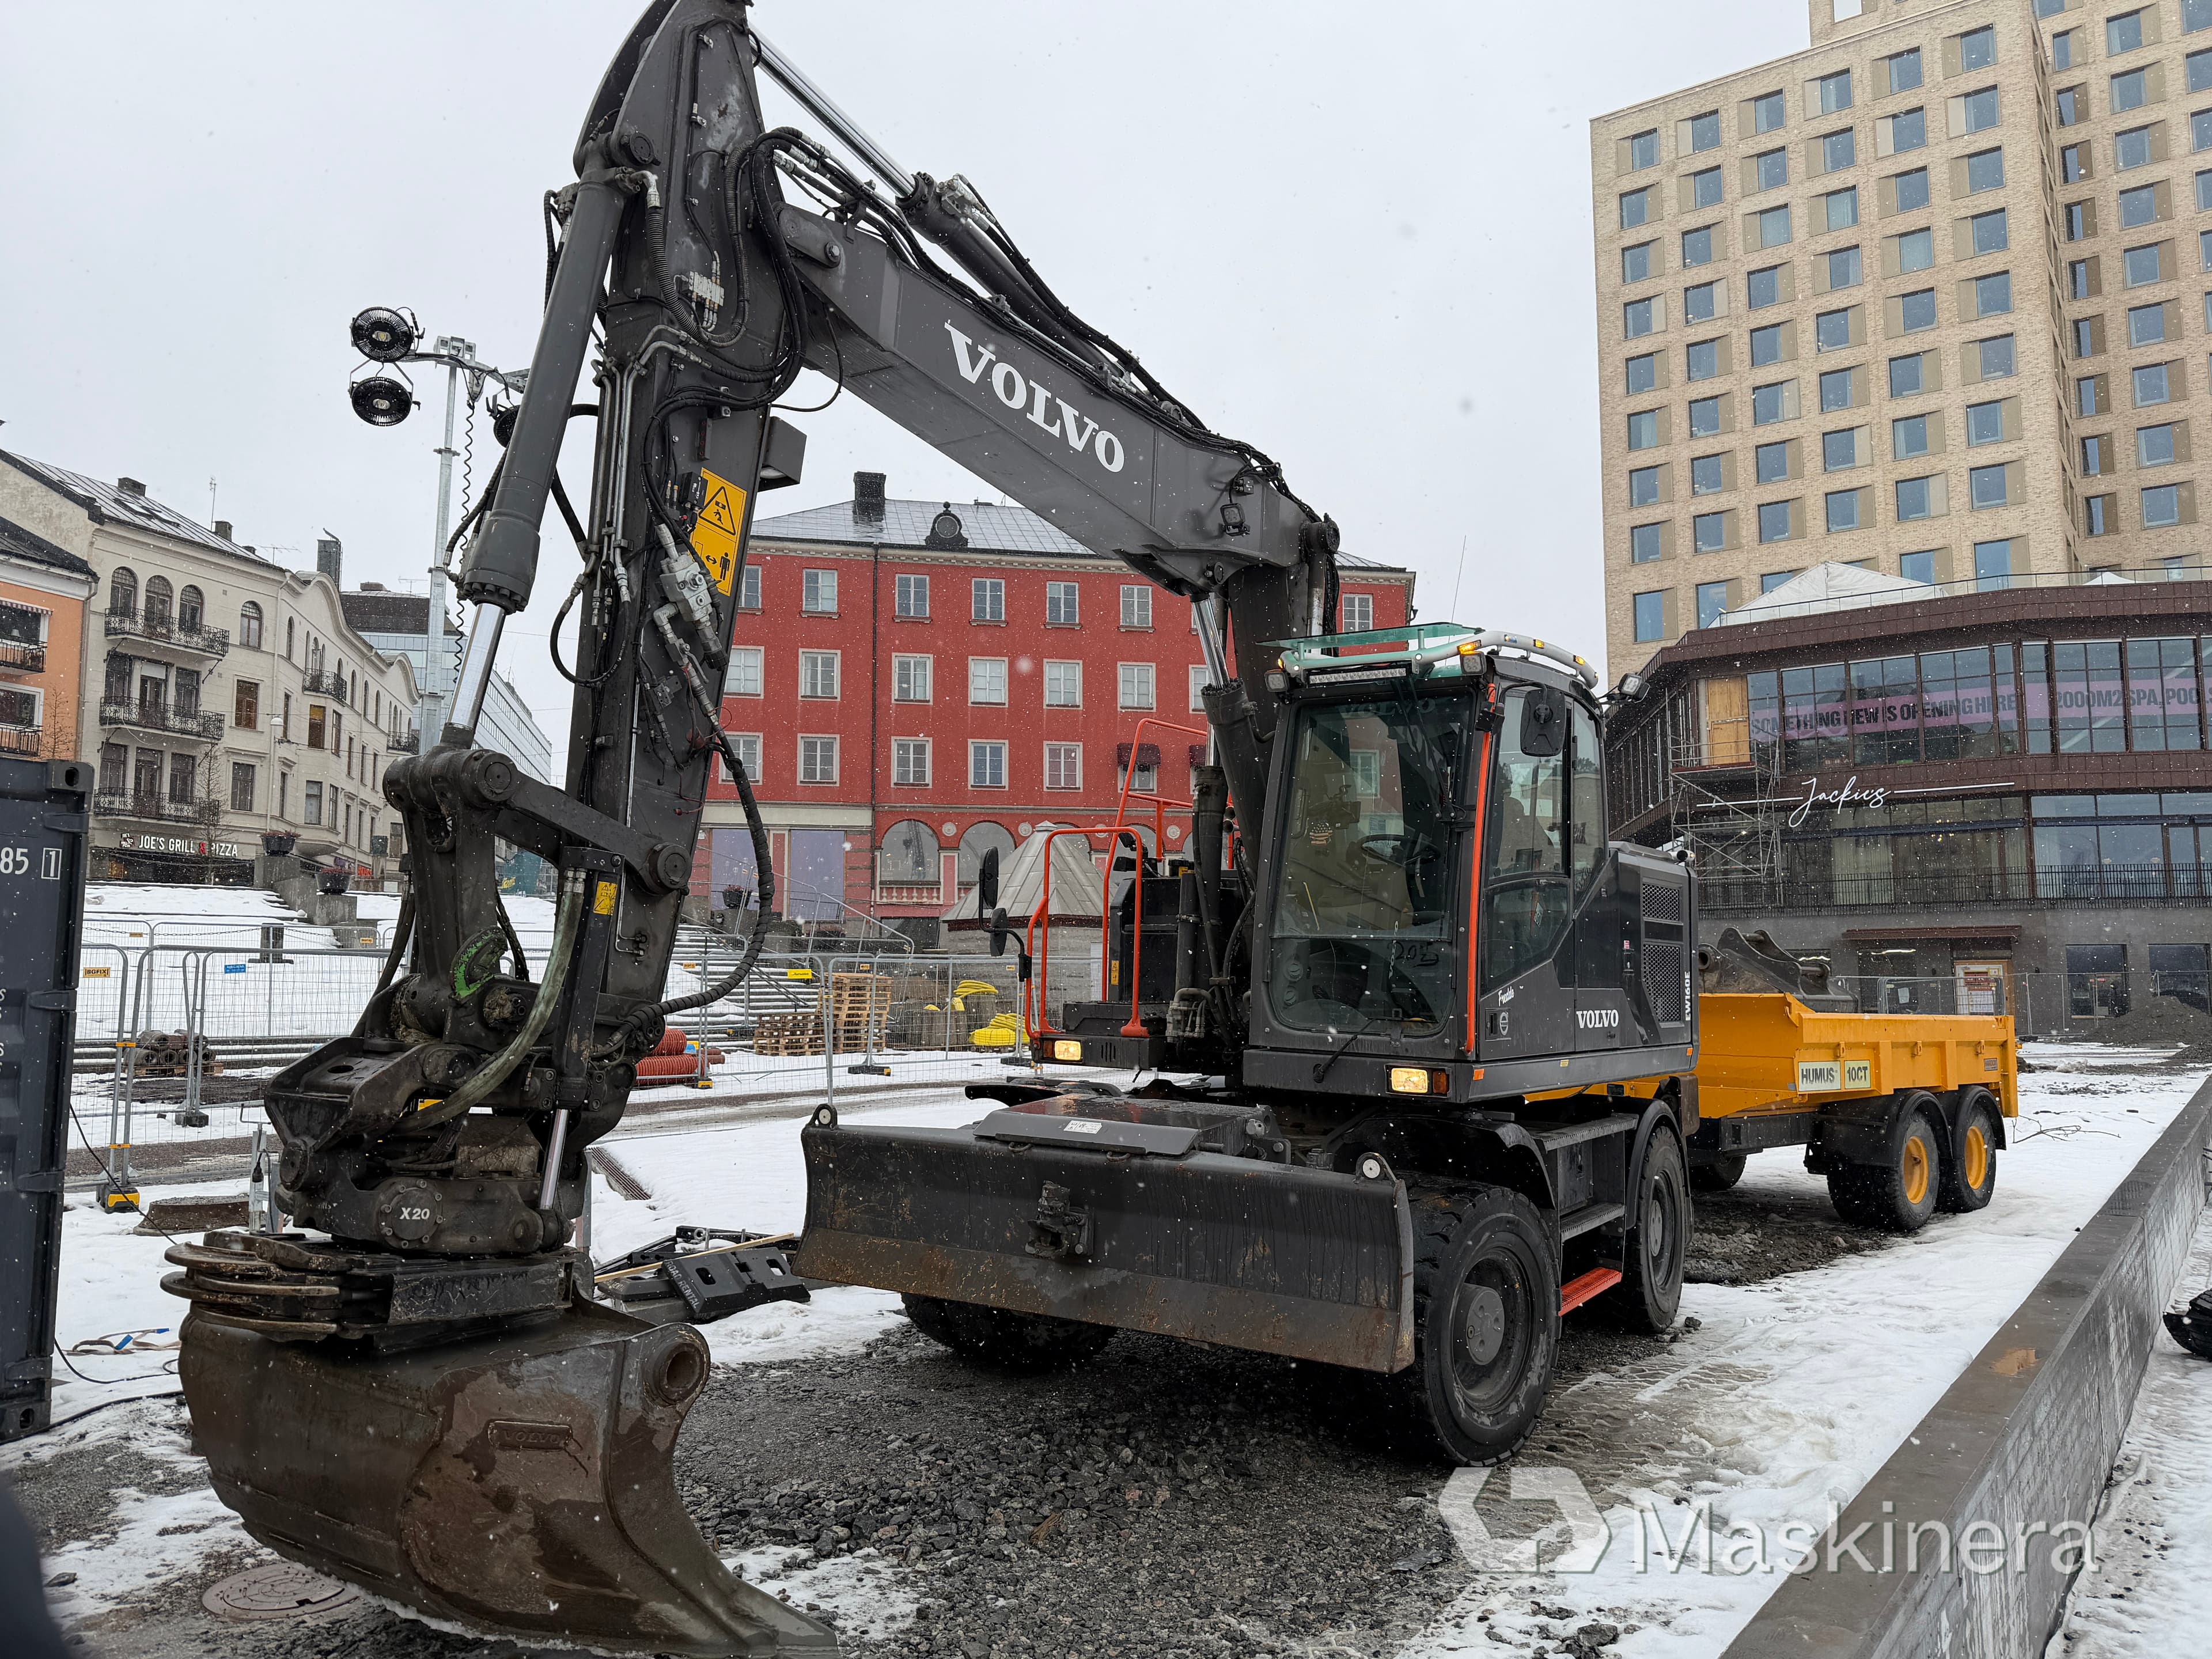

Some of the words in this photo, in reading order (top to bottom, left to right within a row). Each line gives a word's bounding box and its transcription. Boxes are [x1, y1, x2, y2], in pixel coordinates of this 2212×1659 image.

[944, 321, 1124, 472] VOLVO
[2164, 687, 2212, 705] POO
[1752, 710, 1841, 734] SOMETHING
[1843, 707, 1878, 725] NEW
[1882, 705, 1897, 722] IS
[1789, 775, 1891, 827] Jackie's
[139, 835, 165, 850] JOE'S
[169, 839, 195, 854] GRILL
[199, 842, 207, 855] &
[0, 847, 29, 874] 85
[50, 851, 56, 877] 1
[1576, 1009, 1619, 1029] VOLVO
[1801, 1066, 1835, 1084] HUMUS
[399, 1207, 430, 1220] X20
[678, 1280, 700, 1309] RENTAL
[501, 1429, 561, 1444] VOLVO
